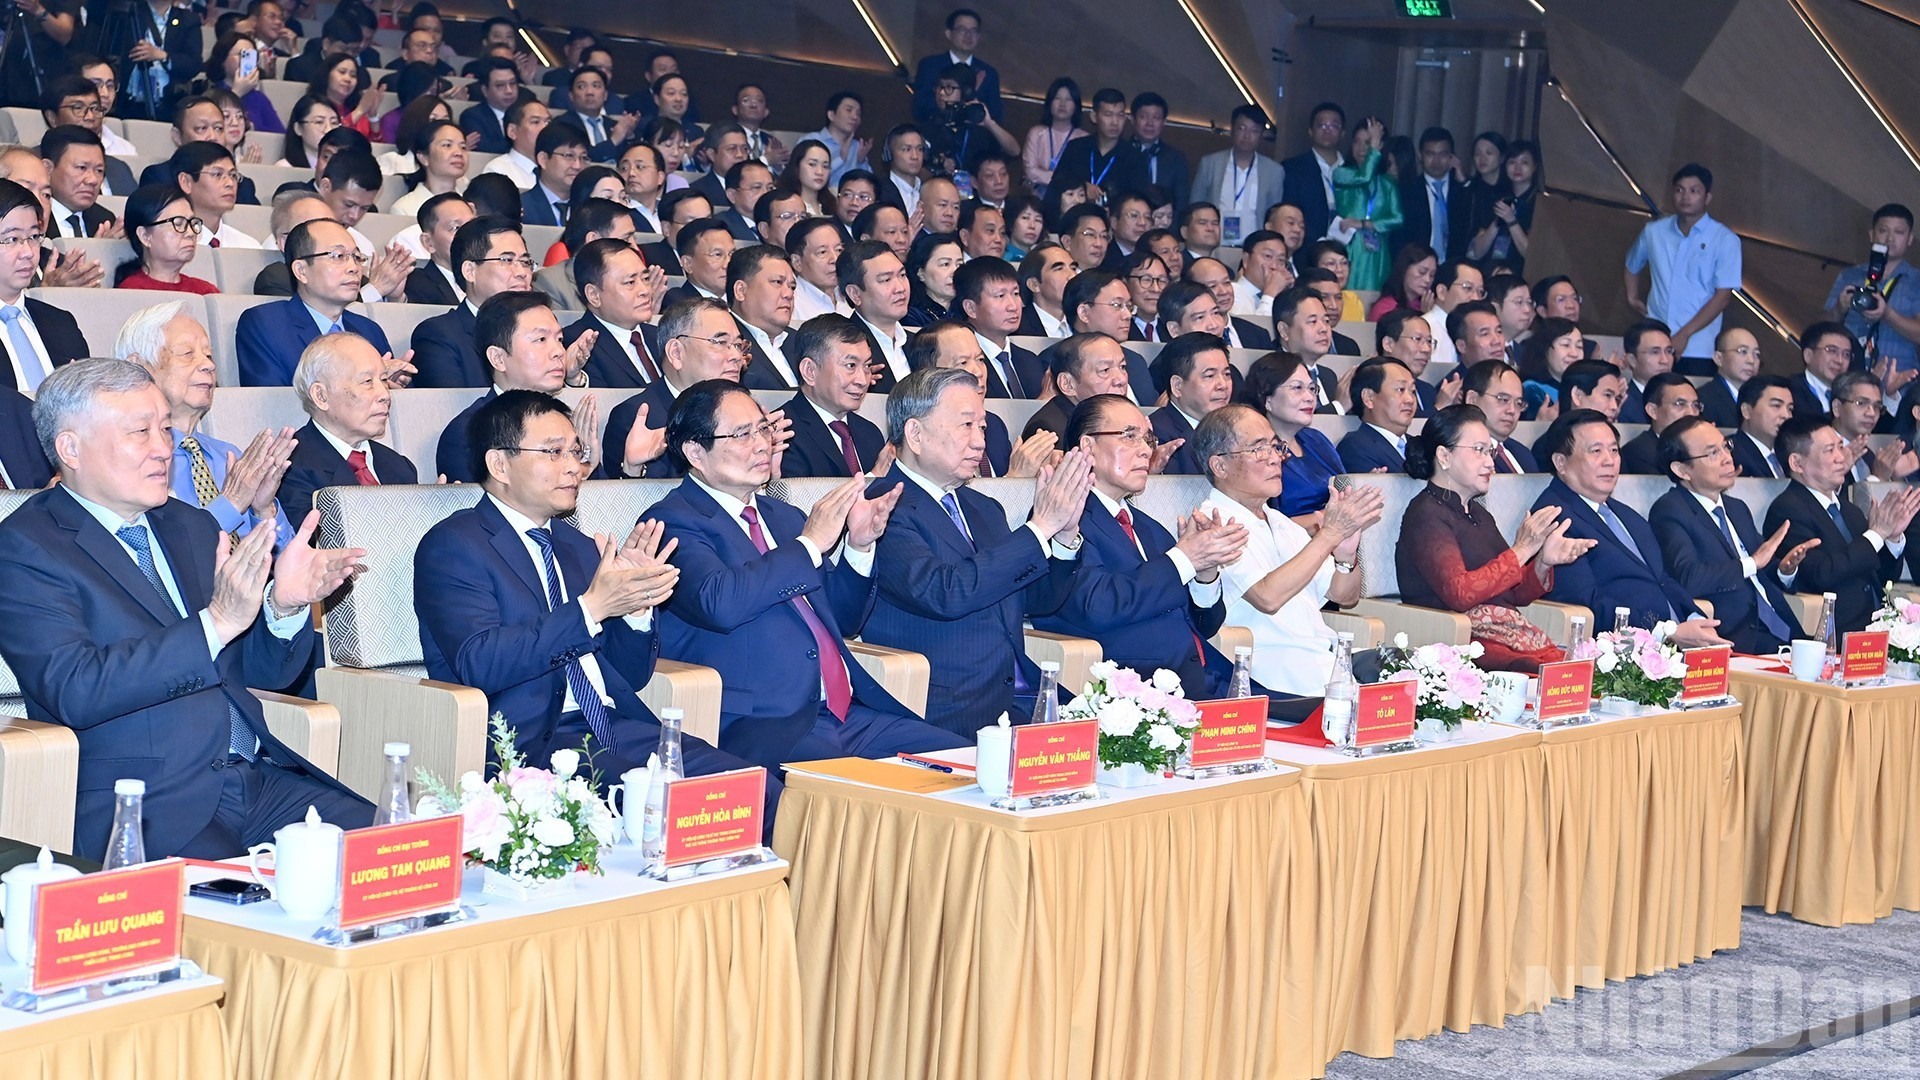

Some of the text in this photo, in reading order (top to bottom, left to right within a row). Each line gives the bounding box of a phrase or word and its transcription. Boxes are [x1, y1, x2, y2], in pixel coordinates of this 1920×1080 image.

[1200, 722, 1256, 740] PHẠM MINH CHÍNH
[1018, 747, 1090, 768] NGUYỄN VĂN THẮNG
[676, 804, 752, 829] NGUYỄN HÒA BÌNH
[351, 855, 450, 886] LƯƠNG TAM QUANG
[56, 910, 164, 944] TRẦN LƯU QUANG
